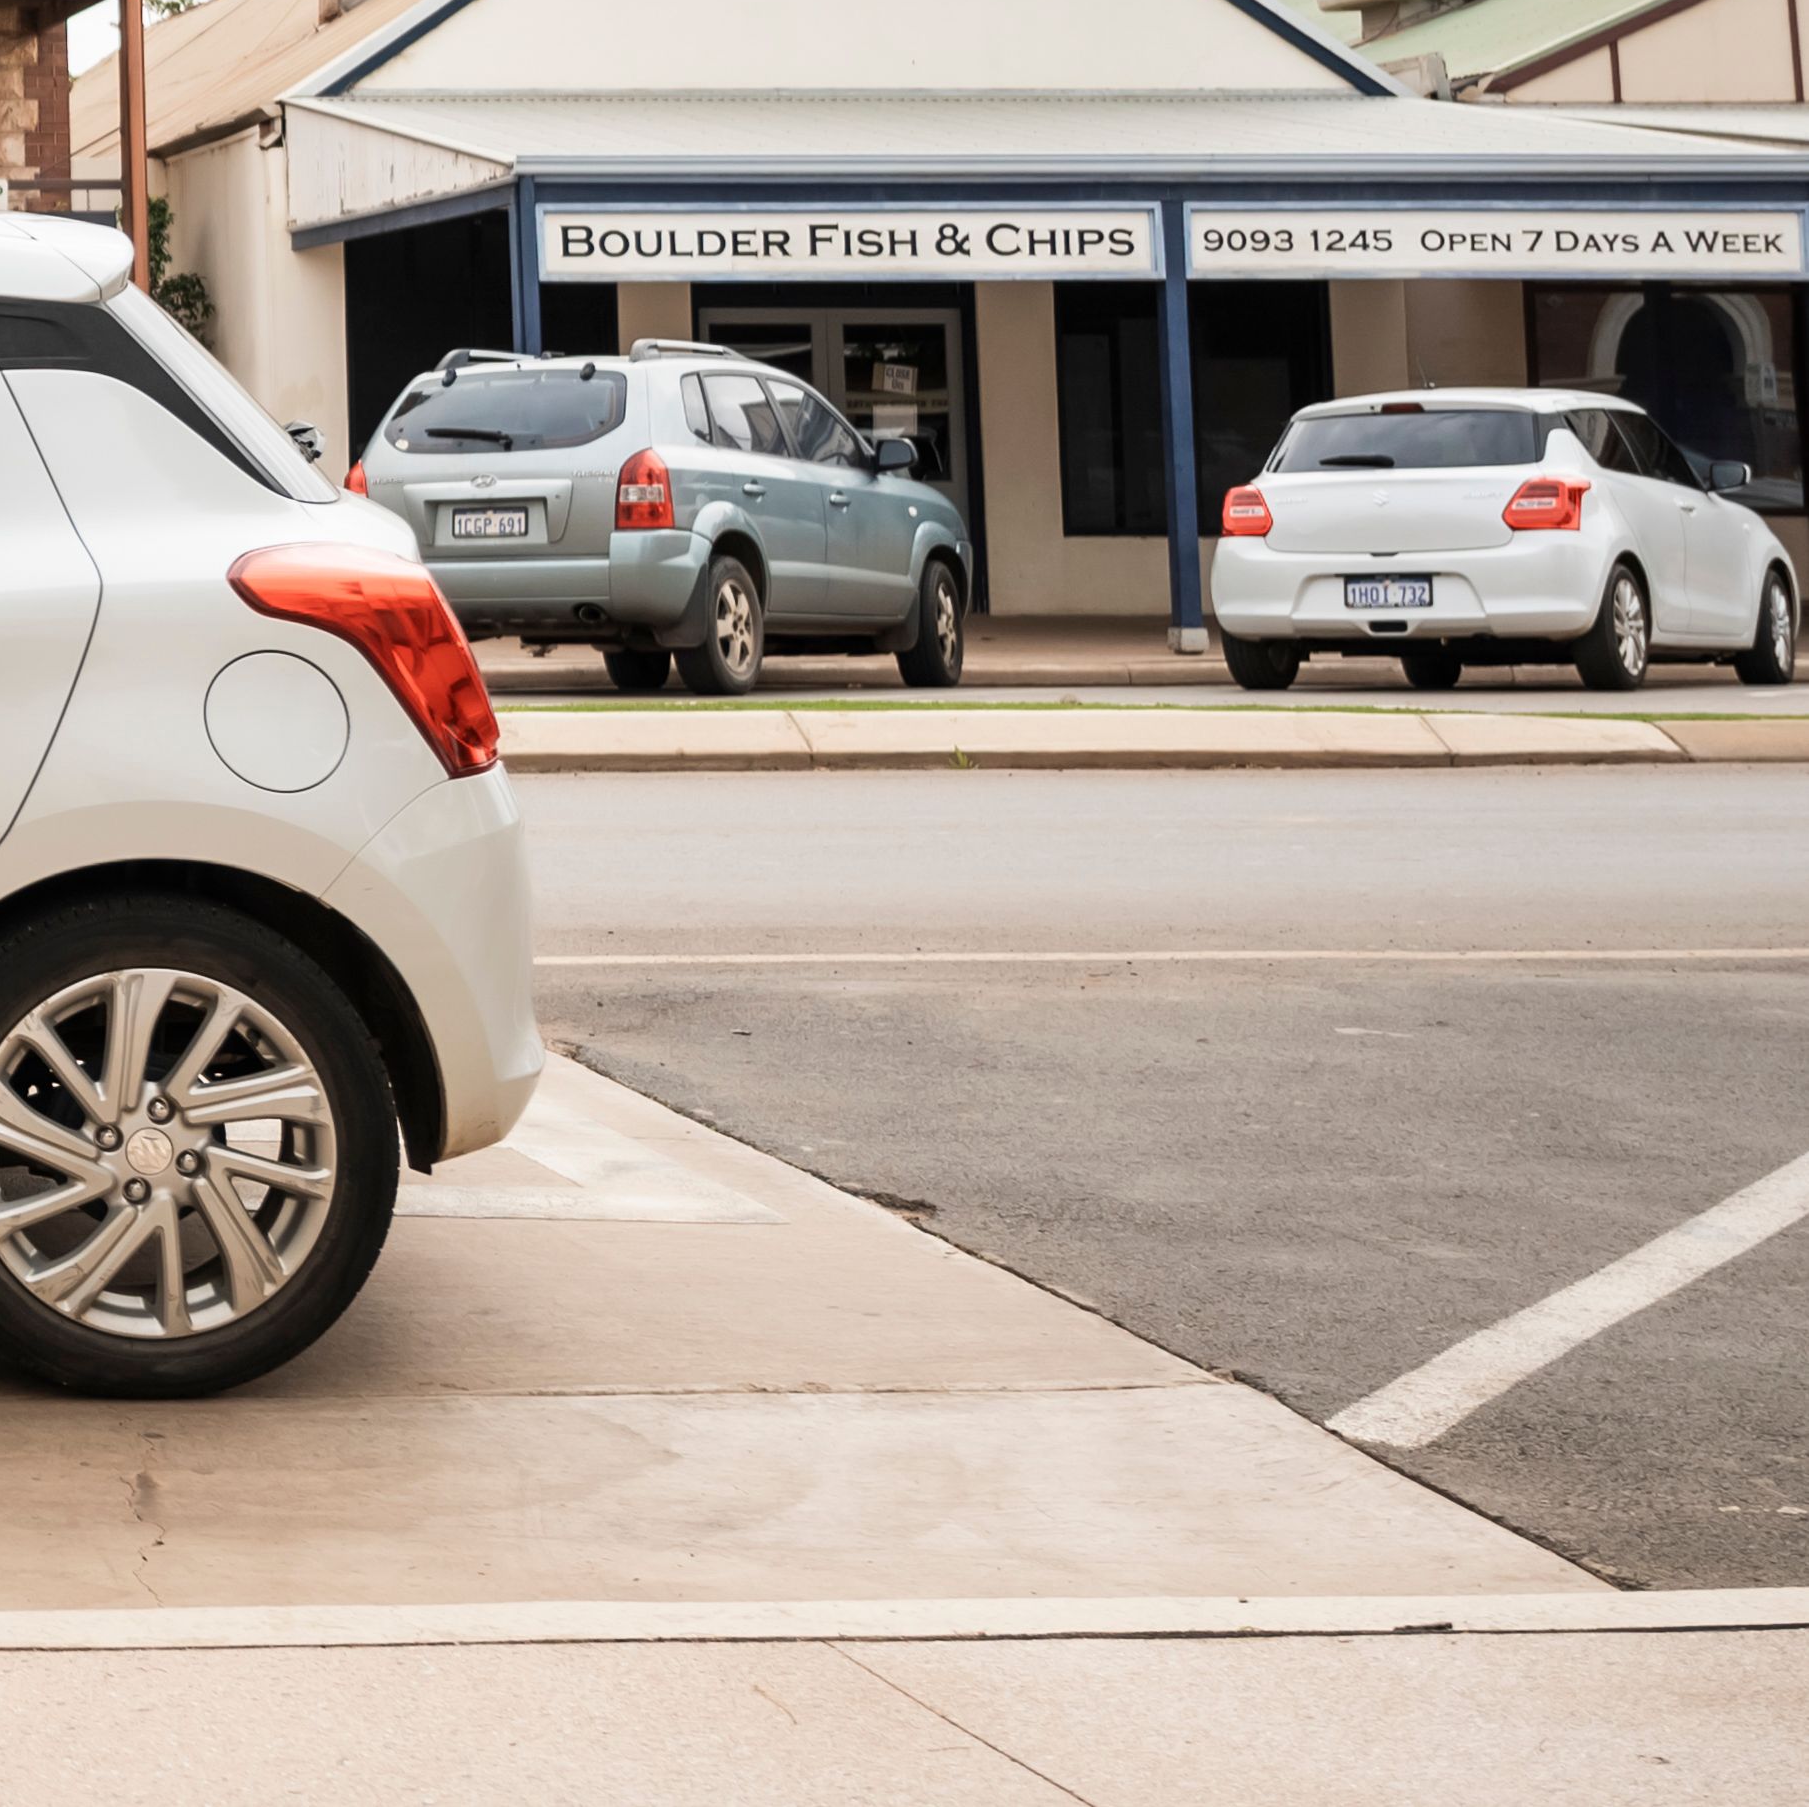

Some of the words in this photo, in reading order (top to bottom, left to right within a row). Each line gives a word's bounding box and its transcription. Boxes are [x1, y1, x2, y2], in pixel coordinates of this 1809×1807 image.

[560, 224, 792, 257] BOULDER
[808, 223, 919, 257] FISH
[934, 223, 971, 257] &
[985, 223, 1135, 257] CHIPS
[1203, 228, 1294, 252] 9093
[1310, 228, 1393, 252] 1245
[1420, 229, 1512, 253] OPEN
[1522, 229, 1544, 252] 7
[1554, 230, 1639, 253] DAYS
[1650, 230, 1675, 253] A
[1683, 230, 1786, 254] WEEK
[458, 517, 493, 535] 1CGP
[499, 516, 523, 534] 691
